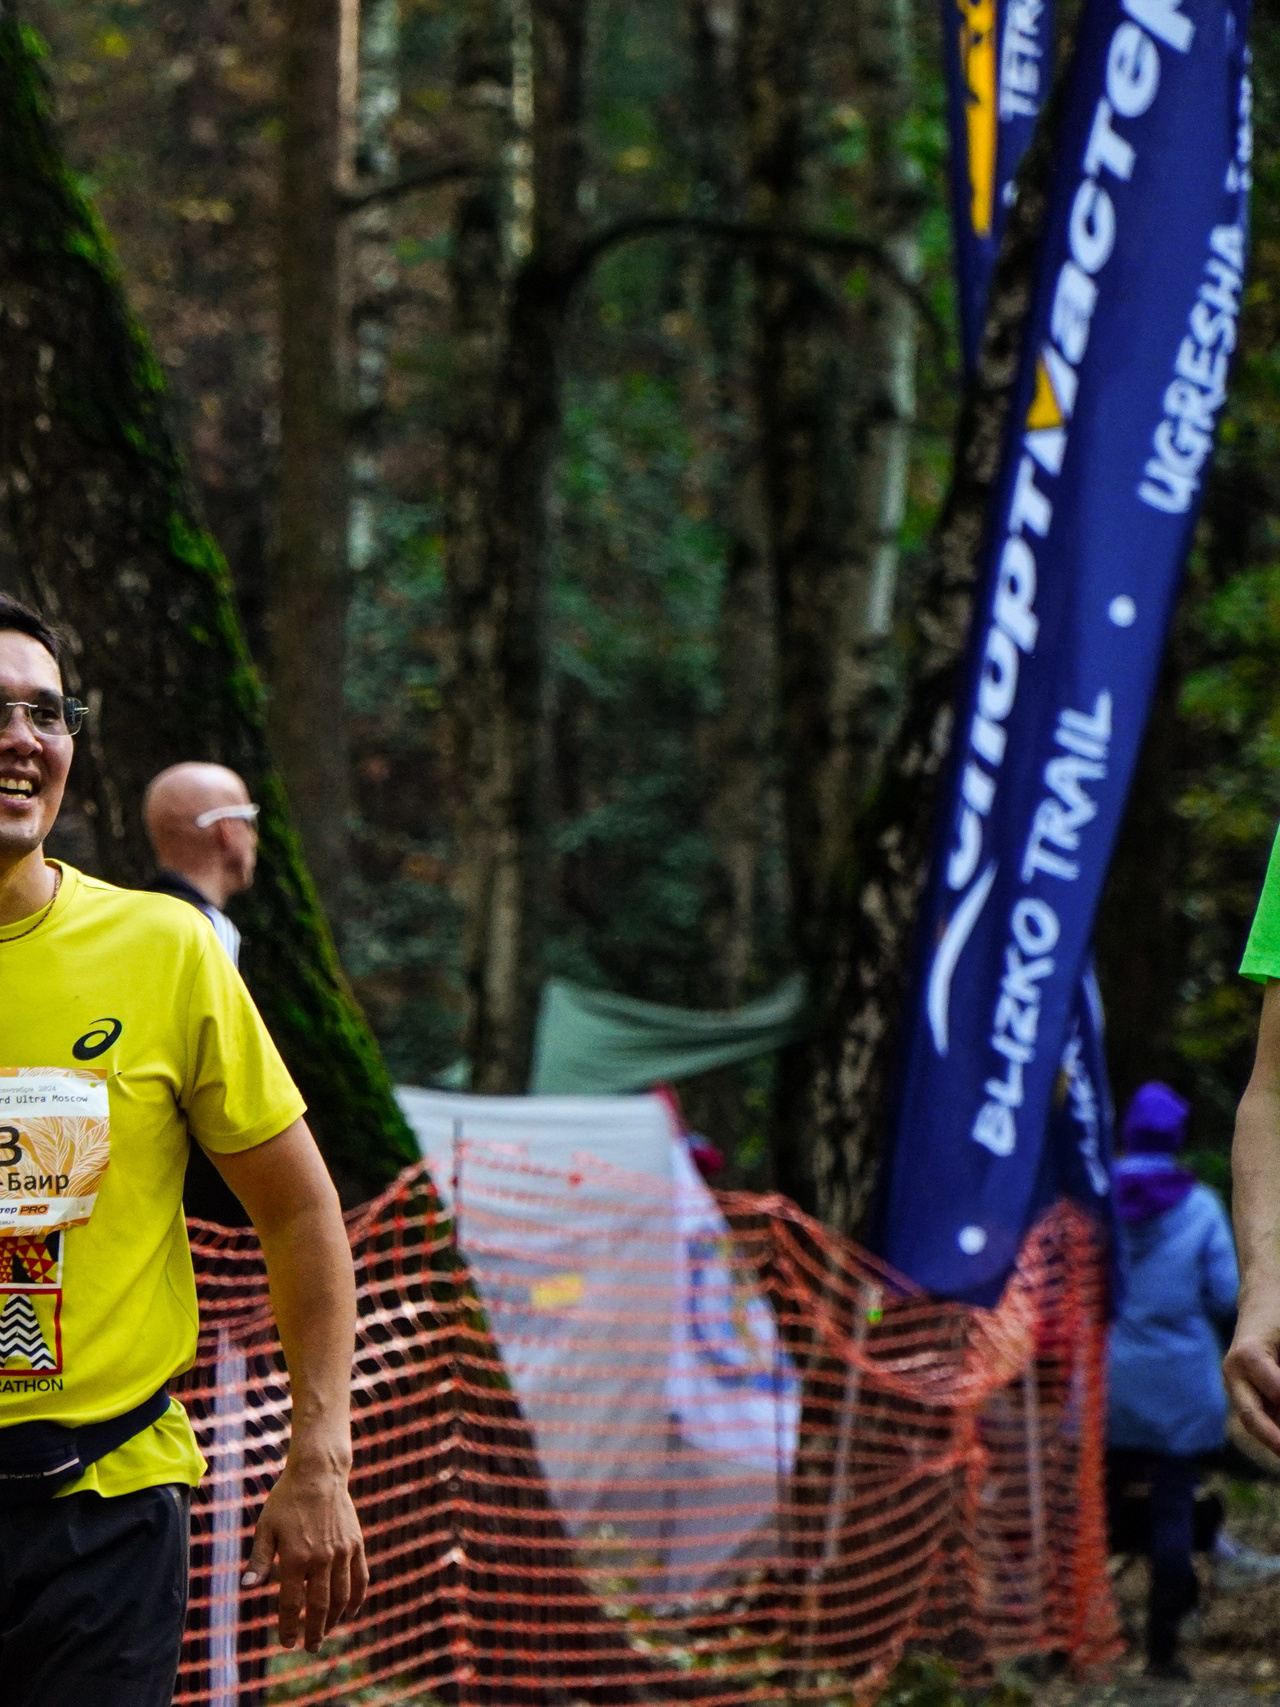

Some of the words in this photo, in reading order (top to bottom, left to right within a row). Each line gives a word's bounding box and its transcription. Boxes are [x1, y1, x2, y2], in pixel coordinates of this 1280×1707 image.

[1137, 223, 1246, 515] UGRESHA
[973, 898, 1061, 1155] BLIZKO
[1021, 688, 1113, 882] TRAIL
[16, 1094, 46, 1104] Ultra
[51, 1094, 88, 1103] Moscow
[20, 1205, 49, 1215] PRO
